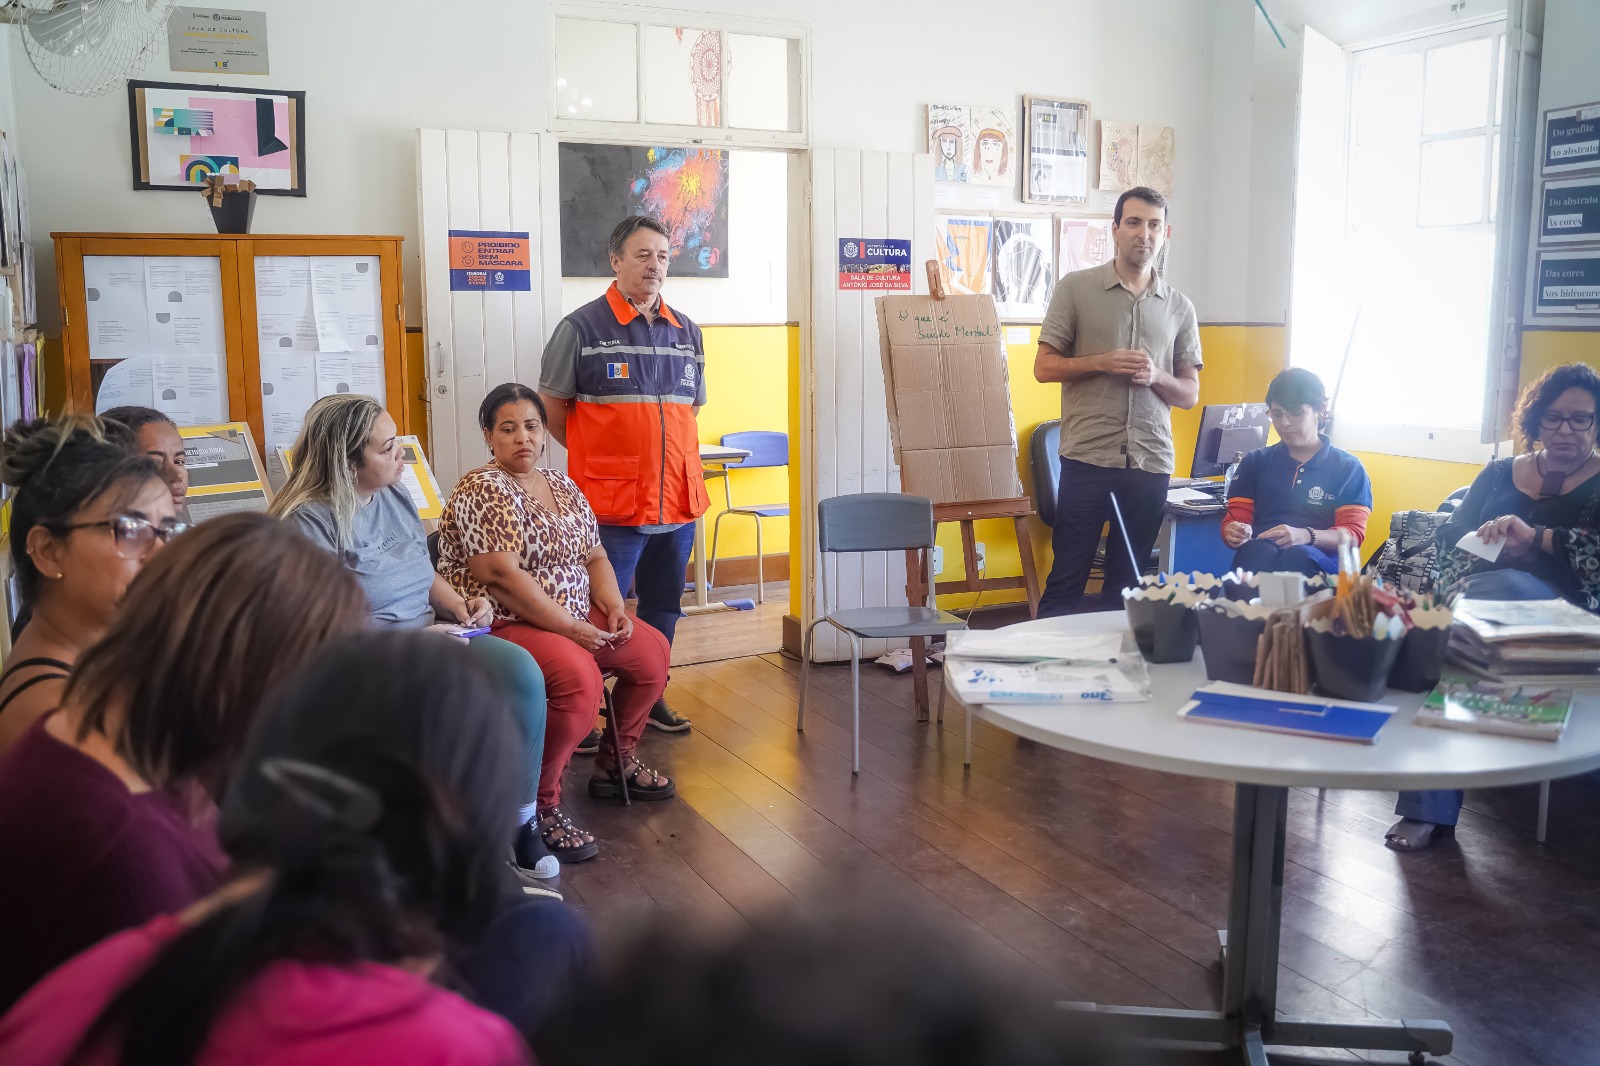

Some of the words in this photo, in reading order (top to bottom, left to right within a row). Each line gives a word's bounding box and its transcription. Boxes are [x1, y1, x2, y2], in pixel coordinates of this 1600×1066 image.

[1552, 128, 1565, 137] Do
[1565, 124, 1595, 137] grafite
[1562, 144, 1599, 156] abstrato
[1549, 198, 1561, 207] Do
[1562, 196, 1599, 206] abstrato
[1559, 218, 1583, 227] cores
[866, 248, 908, 257] CULTURA
[1545, 269, 1561, 278] Das
[1561, 269, 1585, 278] cores
[1560, 288, 1600, 298] hidrocore
[914, 316, 932, 330] que
